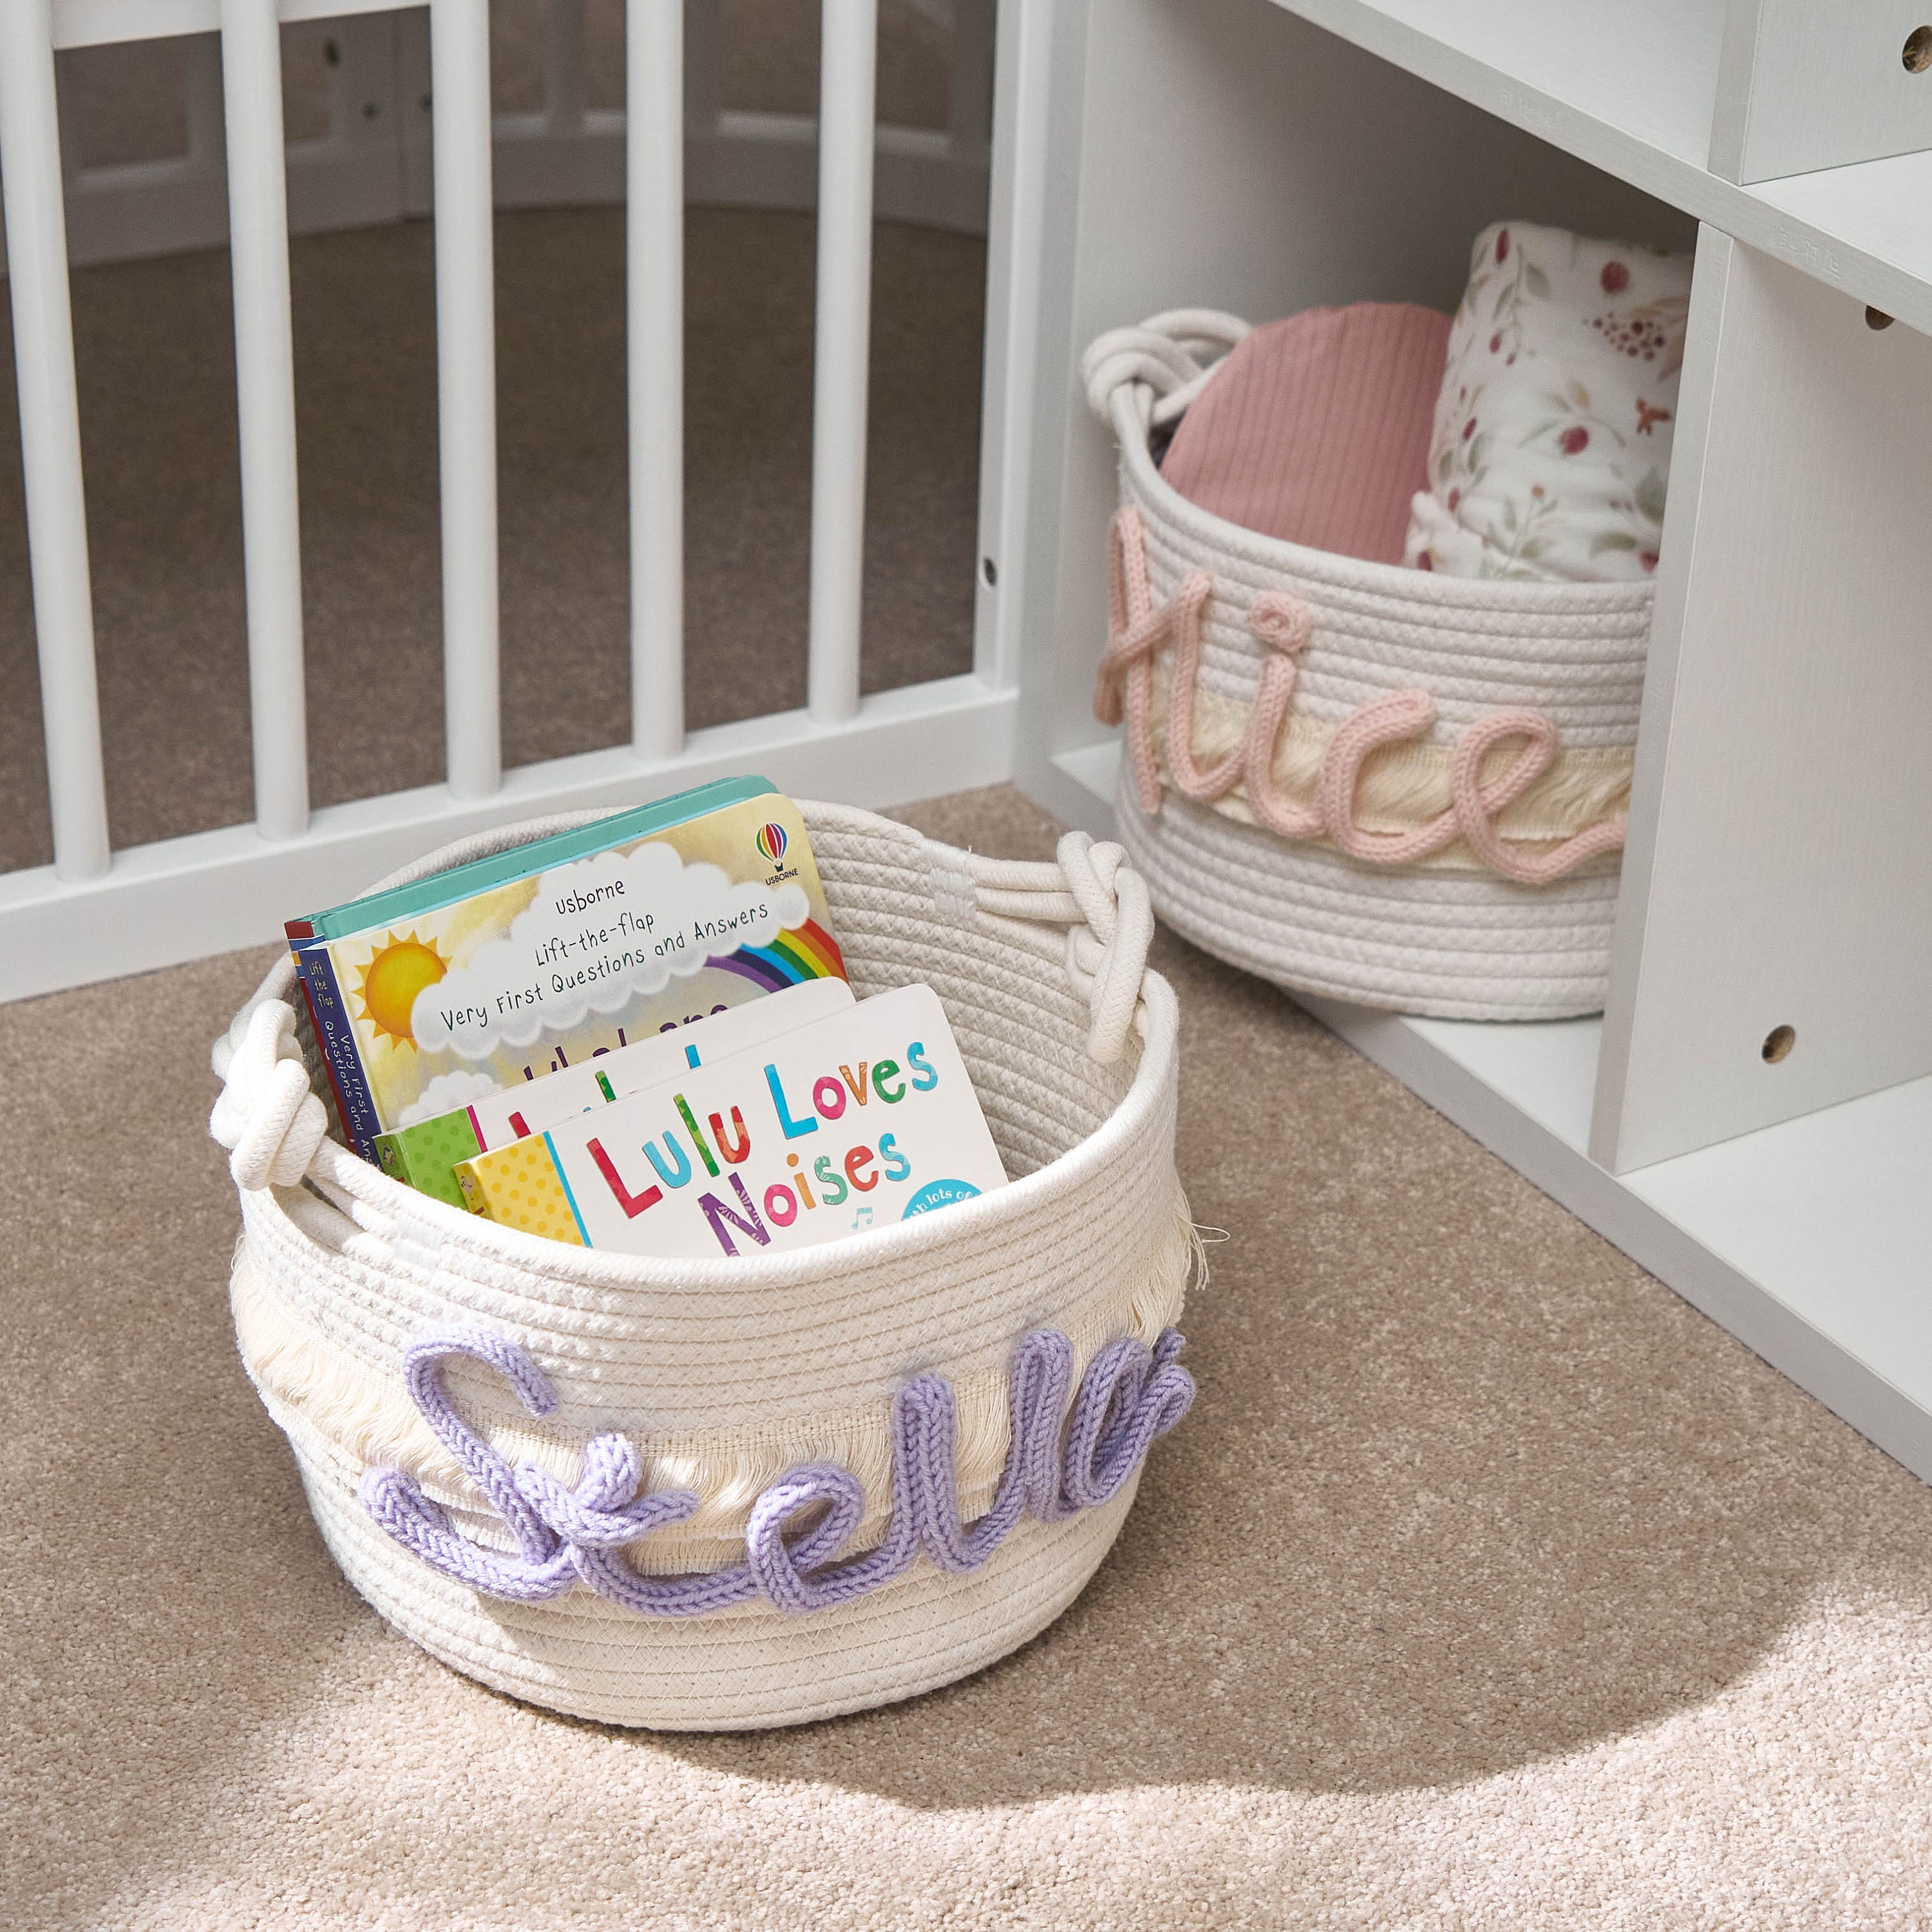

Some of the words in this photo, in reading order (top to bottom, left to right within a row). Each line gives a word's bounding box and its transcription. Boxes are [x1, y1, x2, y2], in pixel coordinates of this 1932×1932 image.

[765, 868, 799, 886] USBORNE
[535, 912, 654, 967] Lift-the-flap
[309, 960, 324, 976] Lift
[314, 980, 328, 992] the
[440, 1006, 488, 1031] Very
[496, 983, 544, 1014] First
[551, 949, 645, 993] Questions
[654, 931, 685, 956] and
[694, 904, 768, 941] Answers
[317, 992, 334, 1010] flap
[324, 1021, 353, 1098] Questions
[350, 1106, 363, 1132] and
[340, 1034, 356, 1070] Very
[352, 1078, 368, 1114] First
[585, 1092, 752, 1219] Lulu
[763, 1041, 938, 1139] Loves
[697, 1132, 911, 1257] Noises
[925, 1188, 952, 1206] lots
